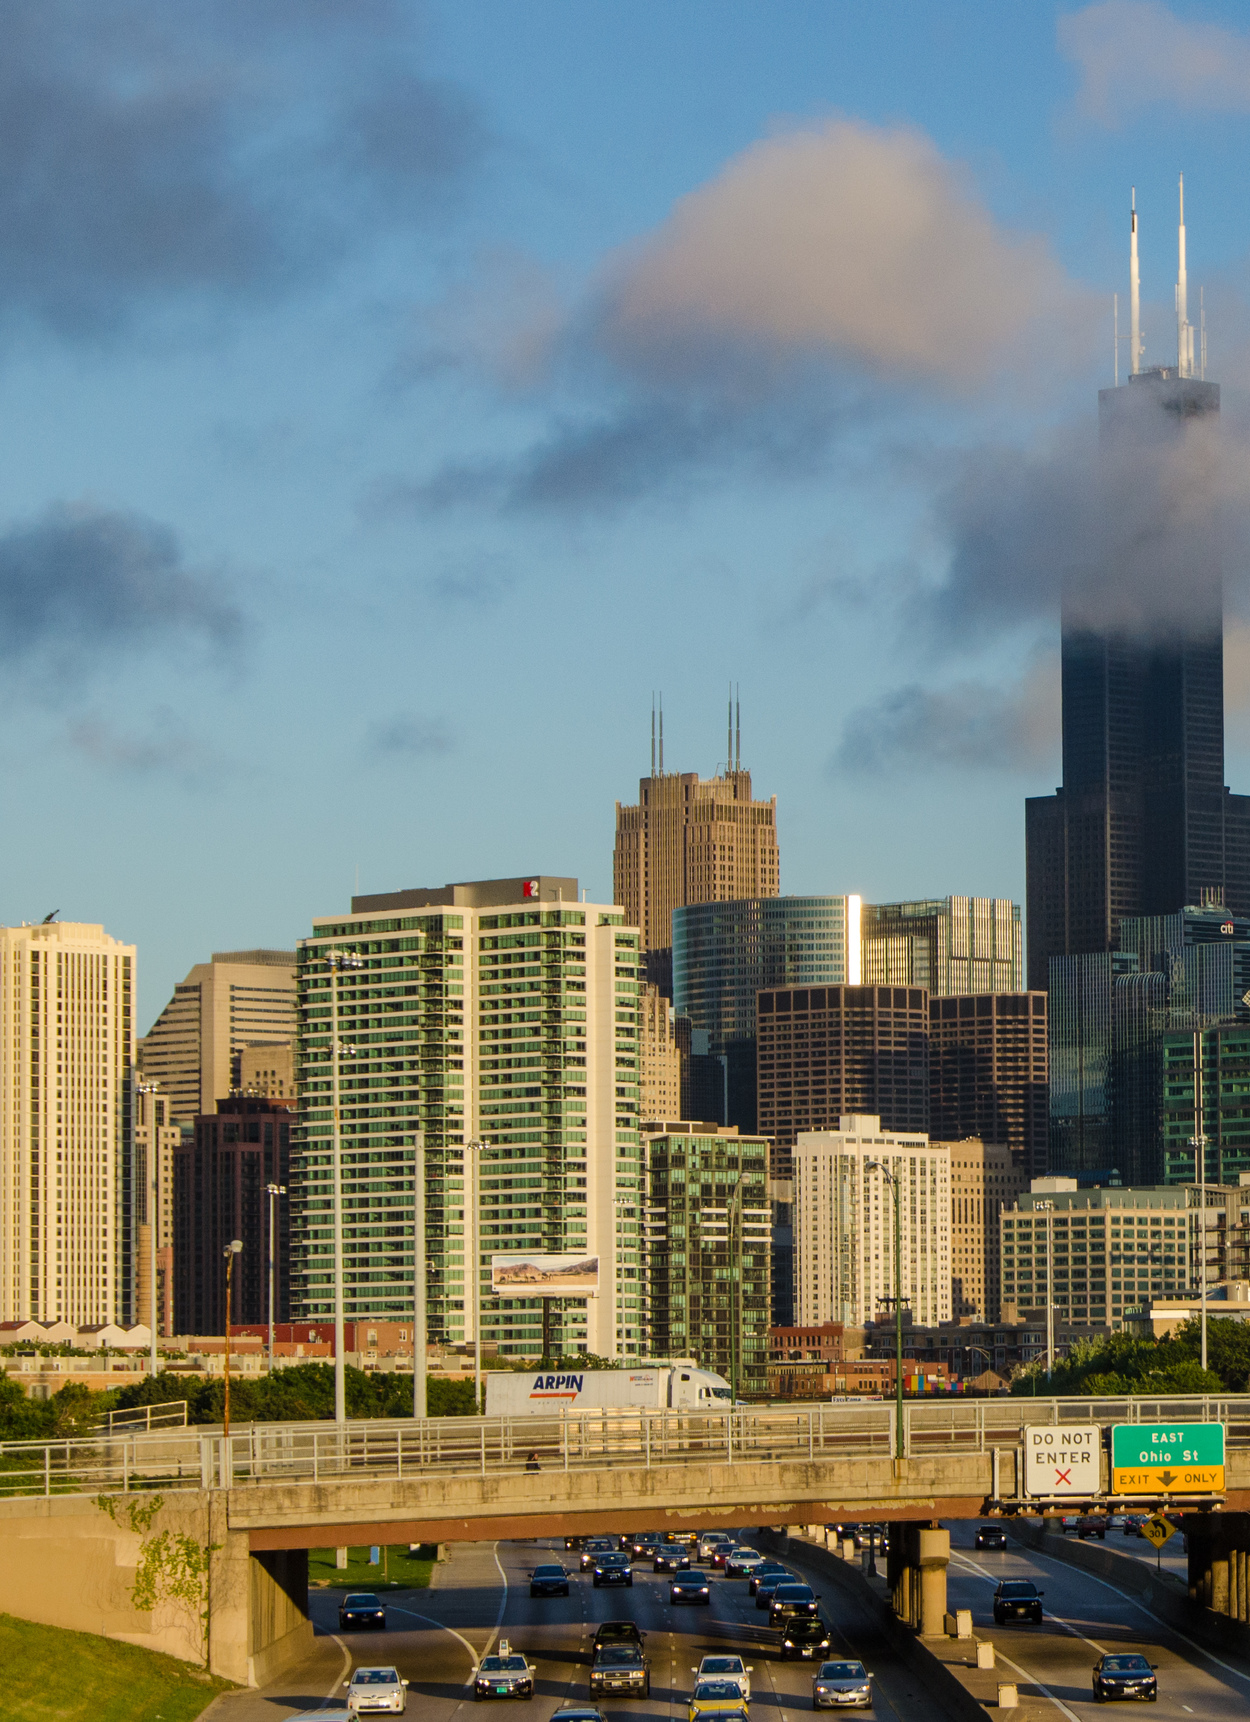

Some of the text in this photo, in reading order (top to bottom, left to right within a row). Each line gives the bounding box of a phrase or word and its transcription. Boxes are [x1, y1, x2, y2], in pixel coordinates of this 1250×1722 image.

[523, 881, 539, 897] K2
[1220, 922, 1234, 934] citi
[533, 1374, 584, 1392] ARPIN
[1033, 1433, 1092, 1445] DO NOT
[1151, 1432, 1184, 1443] EAST
[1036, 1452, 1091, 1464] ENTER
[1139, 1450, 1199, 1462] Ohio St
[1119, 1473, 1217, 1485] EXIT ONLY
[1149, 1530, 1160, 1538] 30
